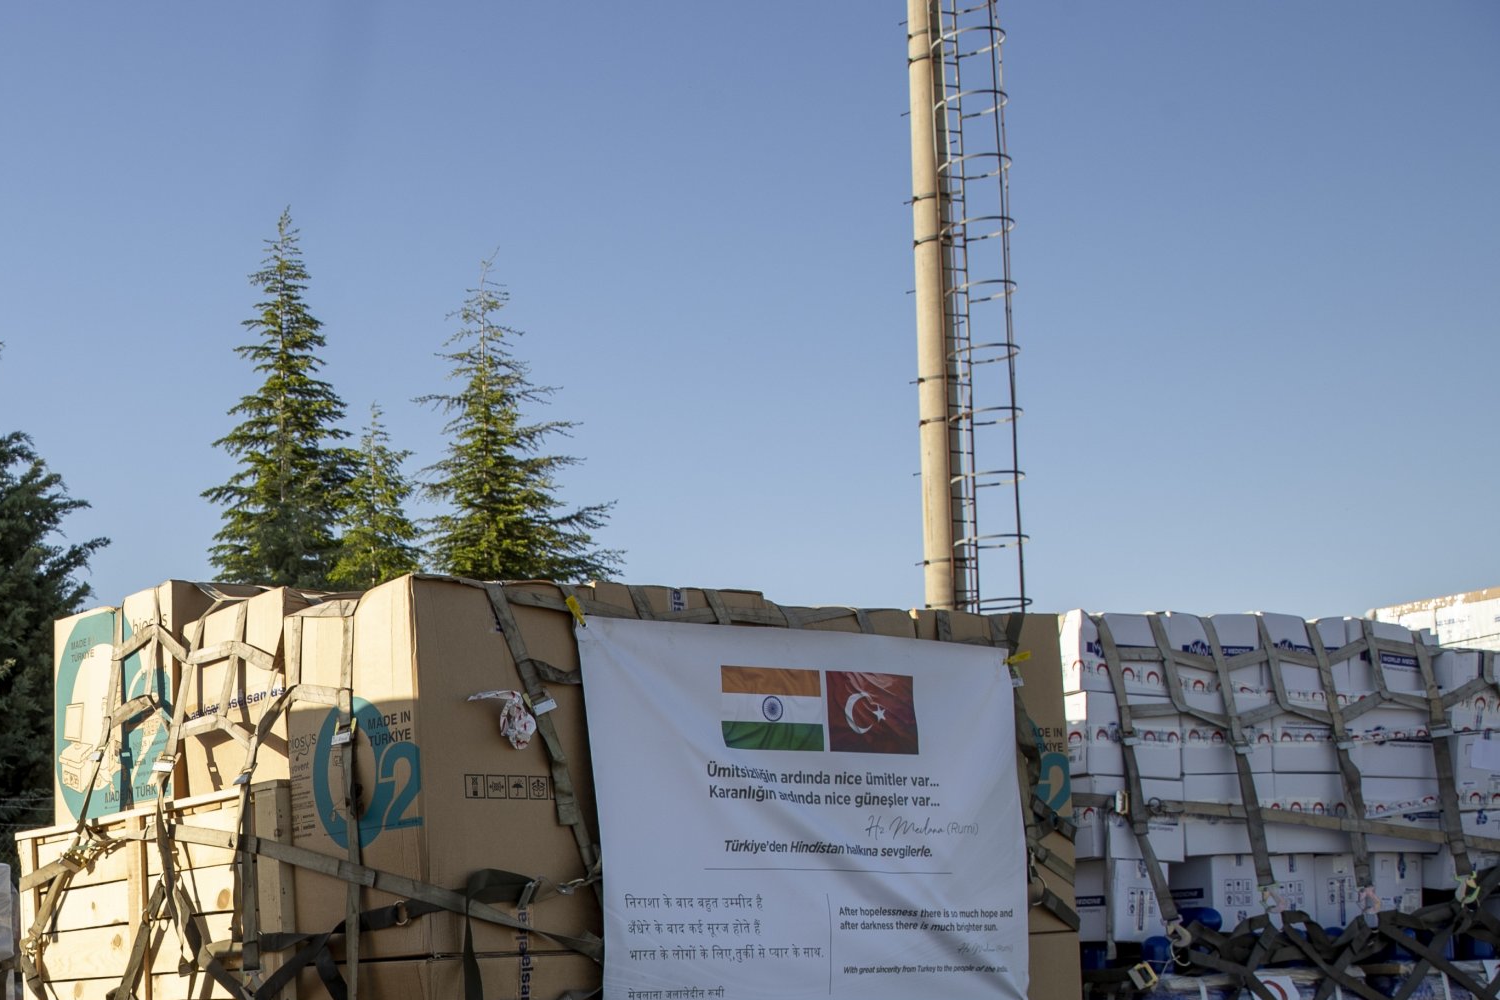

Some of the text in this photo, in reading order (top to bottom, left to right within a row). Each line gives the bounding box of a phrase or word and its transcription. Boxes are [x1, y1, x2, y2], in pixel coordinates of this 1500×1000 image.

[368, 710, 411, 730] MADE IN
[370, 728, 411, 746] TÜRKİYE
[1032, 728, 1063, 738] ADE IN
[1036, 739, 1063, 752] RKİYE
[707, 761, 940, 788] Ümitsizliğin ardında nice ümitler var...
[708, 784, 941, 810] Karanlığın ardında nice güneşler var...
[946, 822, 979, 837] (Rumi)
[724, 840, 933, 861] Türkiye'den Hindistan halkına sevgilerle.
[839, 906, 858, 917] After
[859, 906, 918, 918] hopelessness
[920, 907, 942, 918] there
[943, 908, 950, 918] is
[959, 909, 979, 919] much
[980, 909, 999, 920] hope
[999, 908, 1013, 918] and
[840, 920, 998, 934] after darkness there is much brighter sun.
[858, 966, 875, 976] great
[875, 965, 901, 976] sincerity
[902, 965, 917, 974] from
[917, 965, 936, 975] Turkey
[952, 965, 973, 975] people
